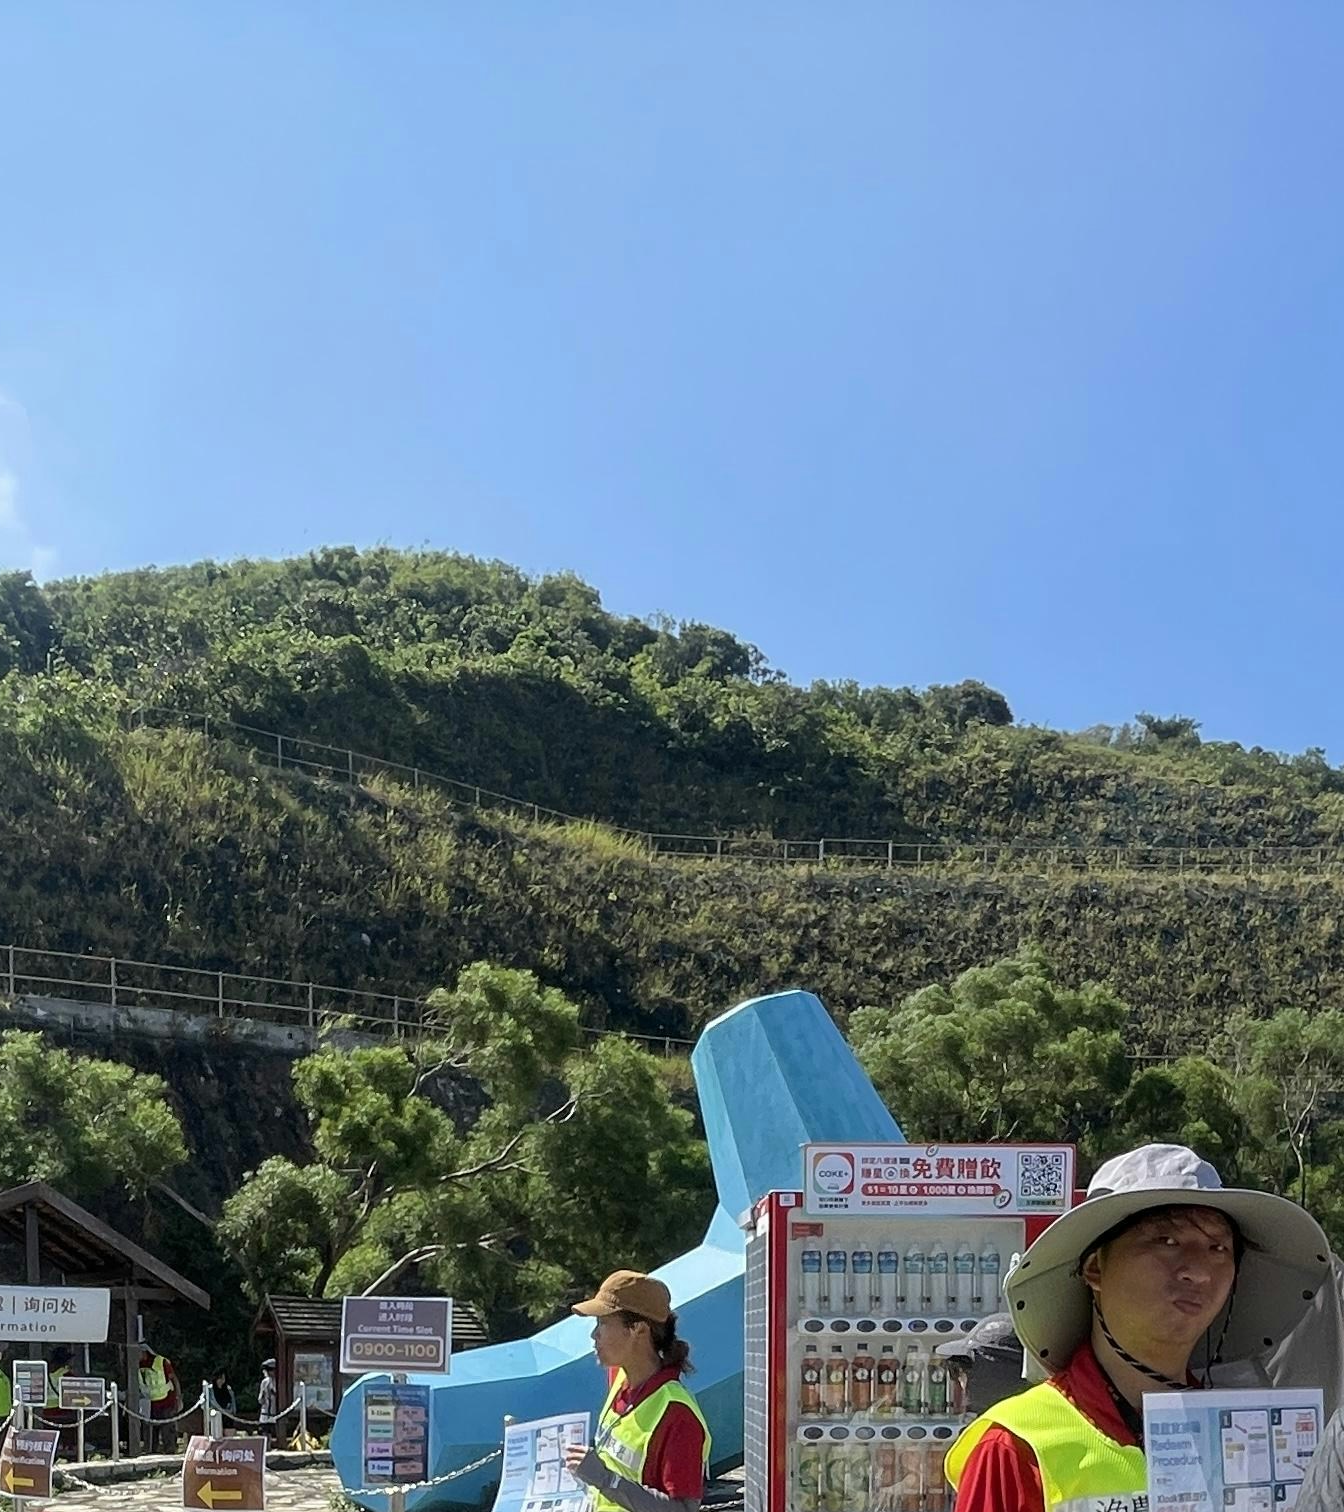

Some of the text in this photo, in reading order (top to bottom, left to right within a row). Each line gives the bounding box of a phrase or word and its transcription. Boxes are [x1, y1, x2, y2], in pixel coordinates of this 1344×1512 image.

[912, 1157, 1001, 1179] 免費贈飲
[24, 1296, 77, 1314] 询问处
[358, 1324, 433, 1334] Current Time Slot
[352, 1342, 437, 1357] 0900-1100
